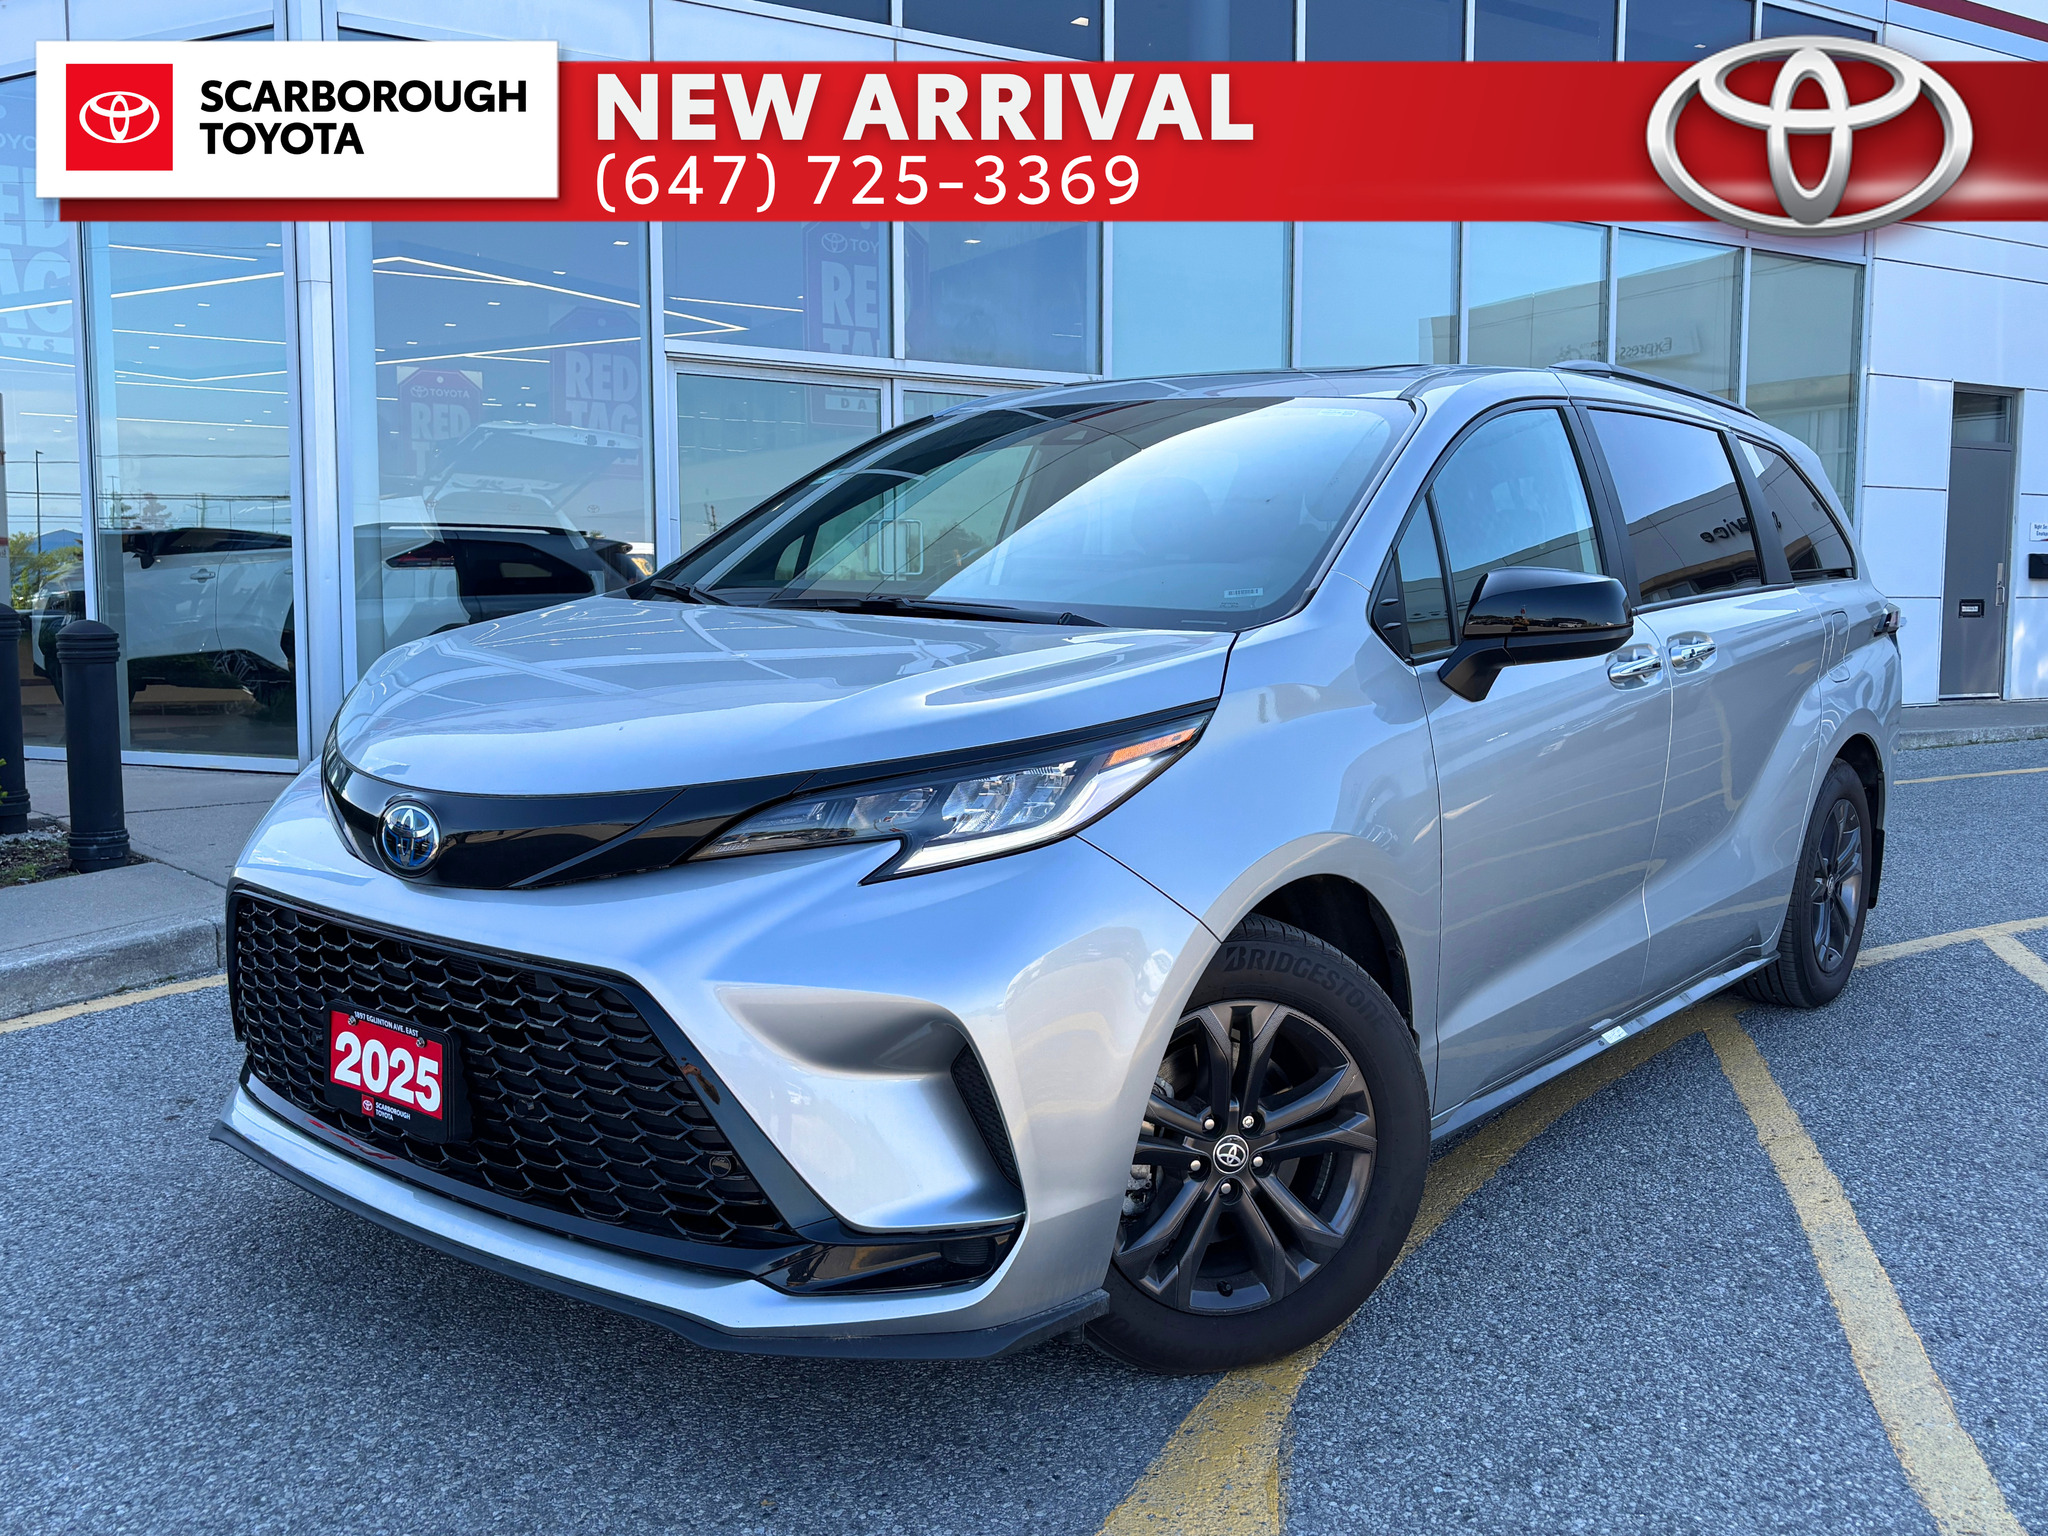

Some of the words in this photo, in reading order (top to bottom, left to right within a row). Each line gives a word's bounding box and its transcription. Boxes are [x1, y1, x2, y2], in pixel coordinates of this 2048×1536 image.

[821, 260, 879, 328] RE
[428, 387, 470, 399] TOYOTA
[565, 350, 639, 402] RED
[410, 402, 471, 442] RED
[1223, 945, 1389, 1030] BRIDGESTONE
[366, 1014, 393, 1029] EGLINTON
[405, 1026, 419, 1037] EAST
[334, 1031, 441, 1112] 2025
[375, 1101, 411, 1120] SCARBOROUGH
[375, 1110, 394, 1121] TOYOTA
